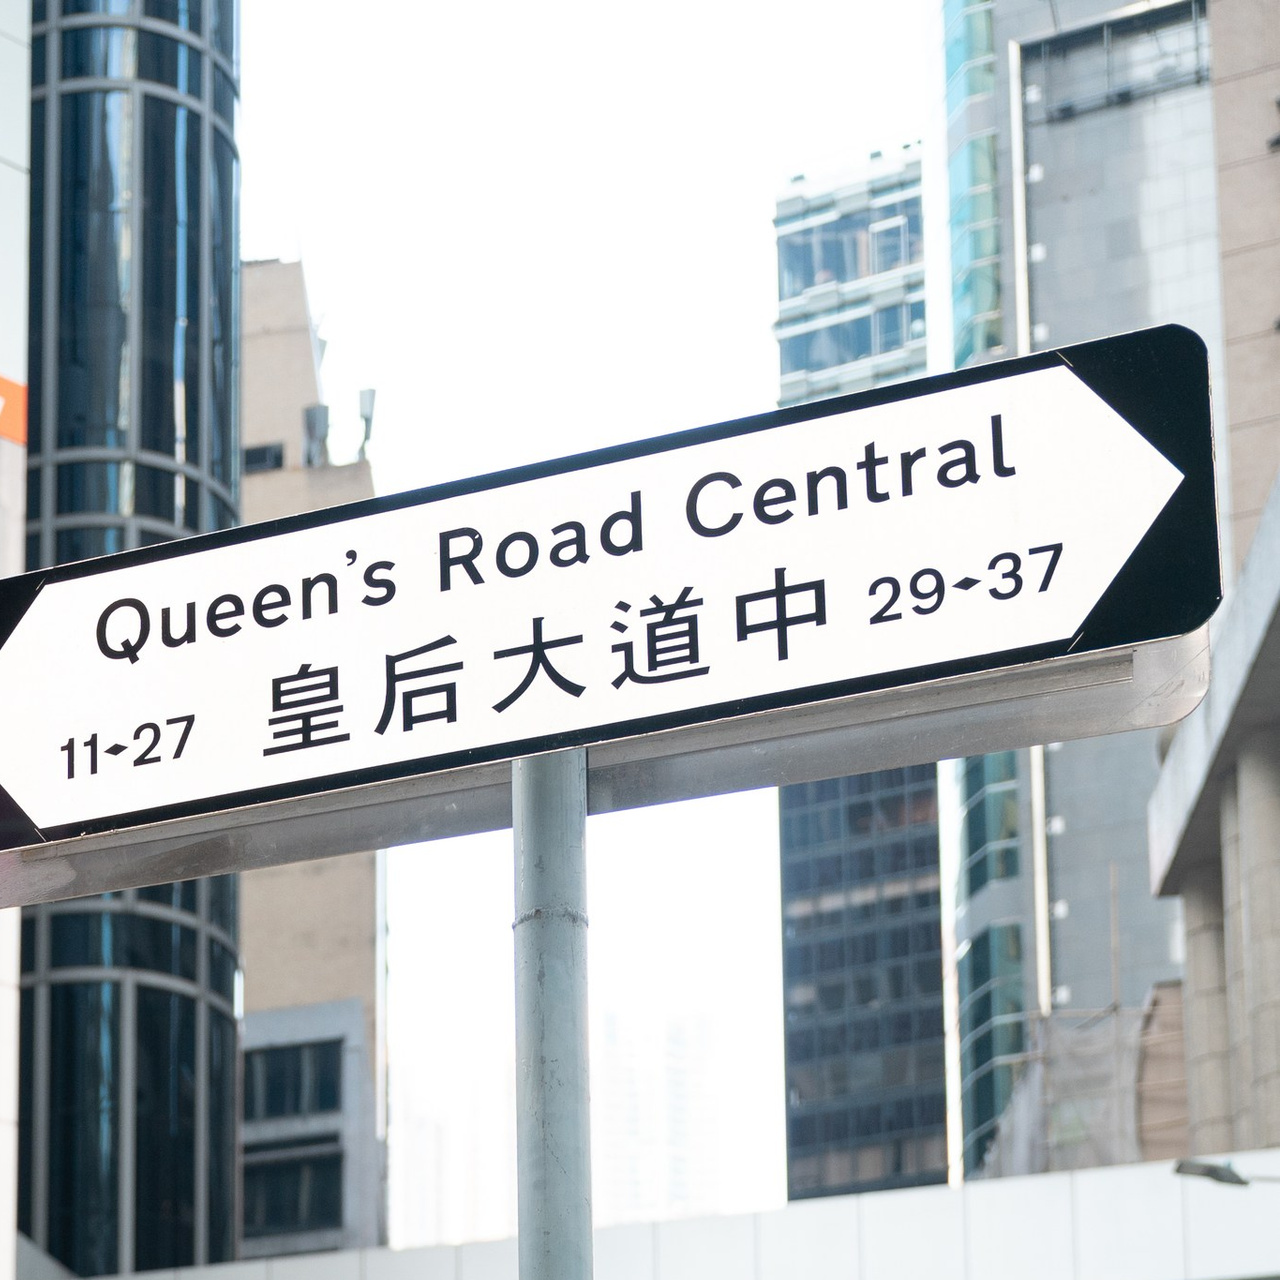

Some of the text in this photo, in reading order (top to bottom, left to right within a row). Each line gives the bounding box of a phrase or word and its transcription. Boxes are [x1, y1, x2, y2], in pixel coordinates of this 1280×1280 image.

[96, 414, 1016, 664] Queen's Road Central
[868, 542, 1063, 625] 29-37
[263, 569, 827, 757] 皇后大道中
[60, 714, 195, 779] 11-27
